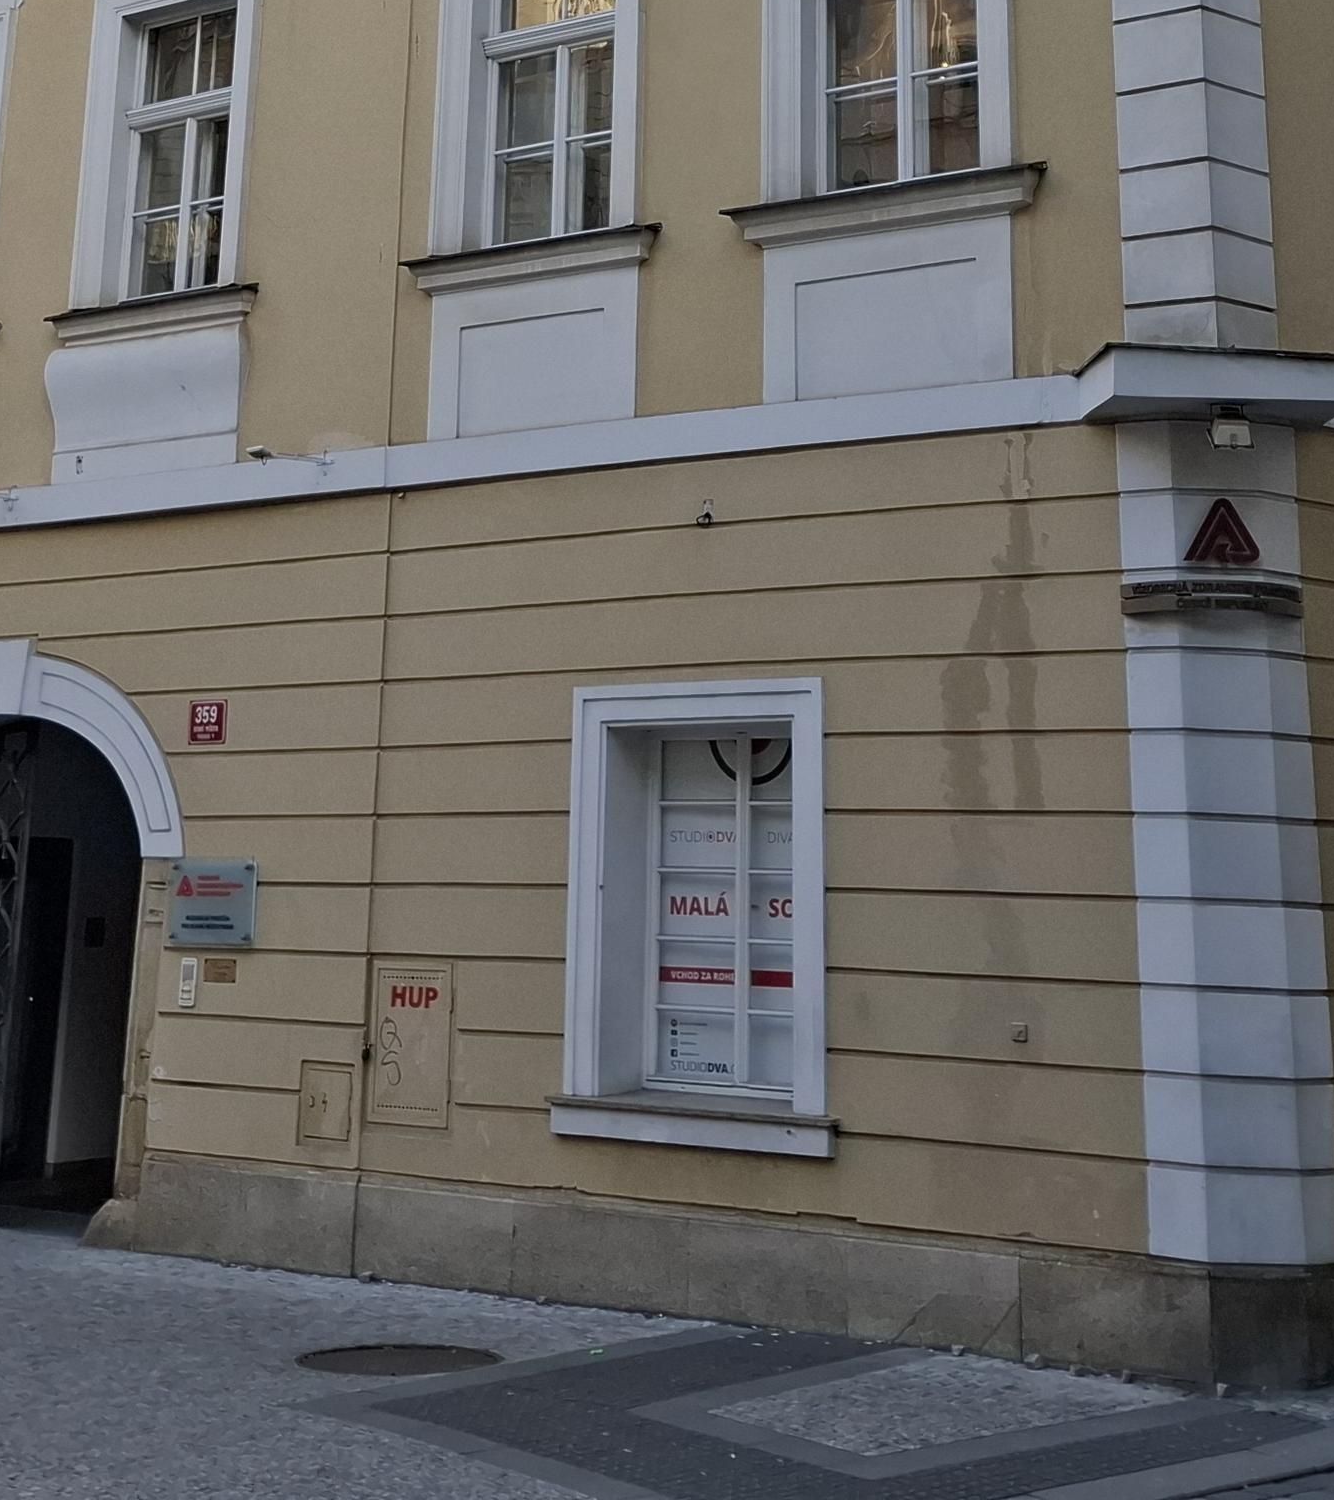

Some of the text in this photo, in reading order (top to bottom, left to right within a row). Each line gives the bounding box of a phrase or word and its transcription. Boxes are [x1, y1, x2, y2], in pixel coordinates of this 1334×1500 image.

[194, 705, 218, 724] 359
[670, 891, 729, 916] MALÁ
[670, 970, 699, 980] VCHOD
[700, 971, 712, 980] ZA
[390, 985, 439, 1009] HUP
